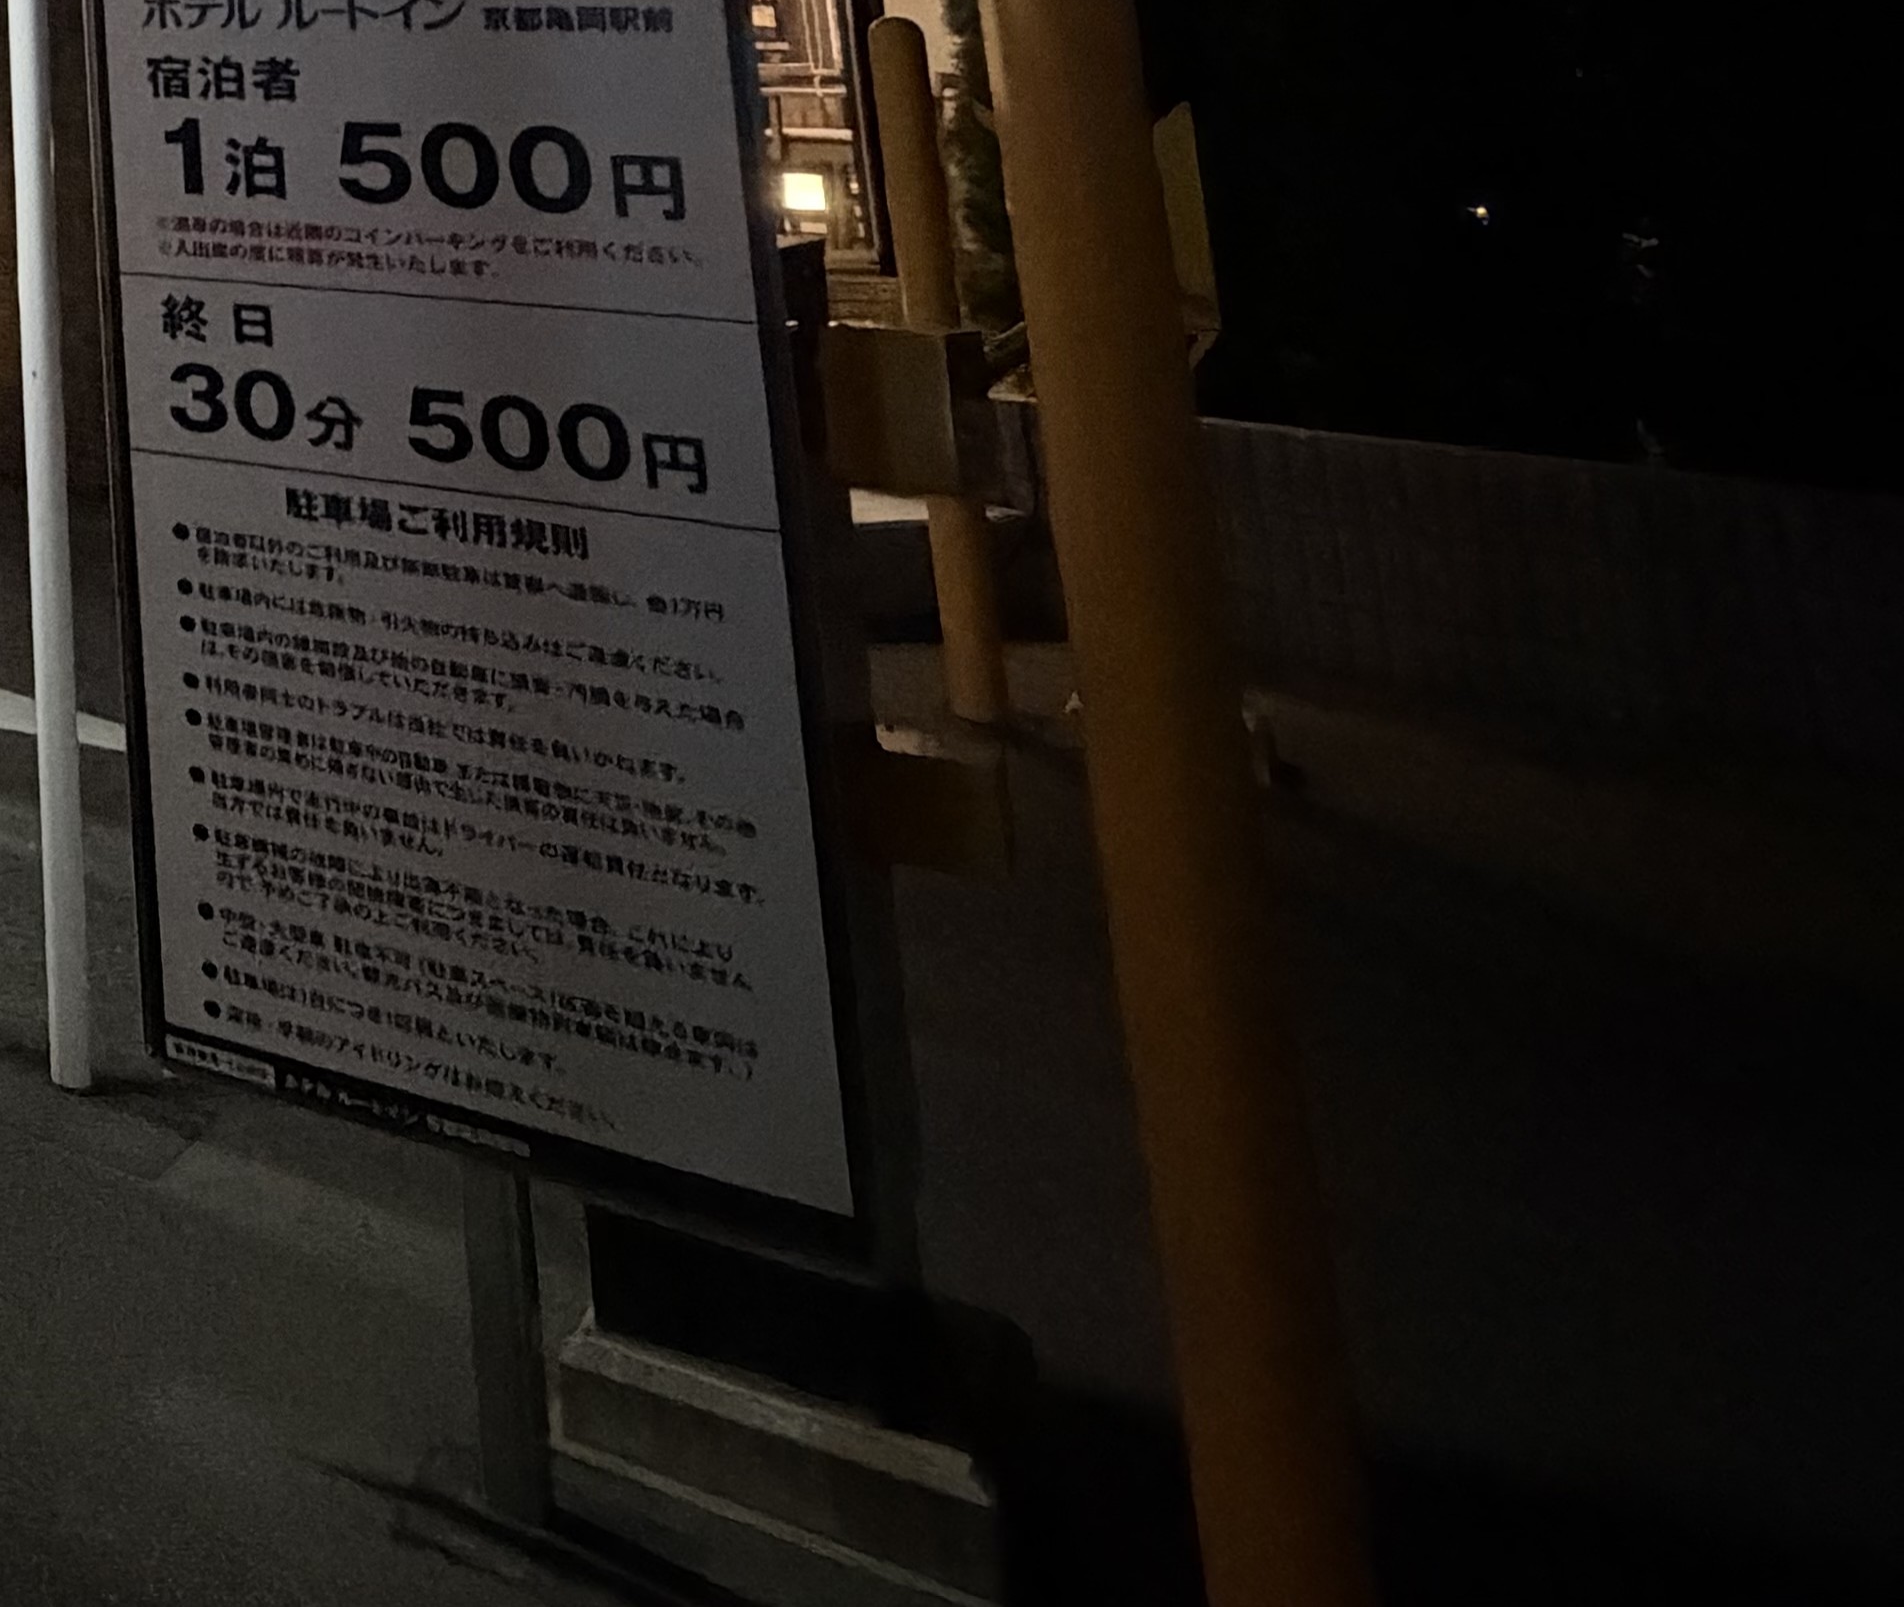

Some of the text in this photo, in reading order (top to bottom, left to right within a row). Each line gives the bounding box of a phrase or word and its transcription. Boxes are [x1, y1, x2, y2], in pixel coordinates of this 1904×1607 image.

[483, 6, 673, 34] 京都亀岡駅前
[147, 57, 300, 101] 宿泊者
[164, 118, 687, 222] 1泊 500円
[169, 363, 709, 495] 30分 500円
[285, 487, 590, 560] 駐車場ご利用規則
